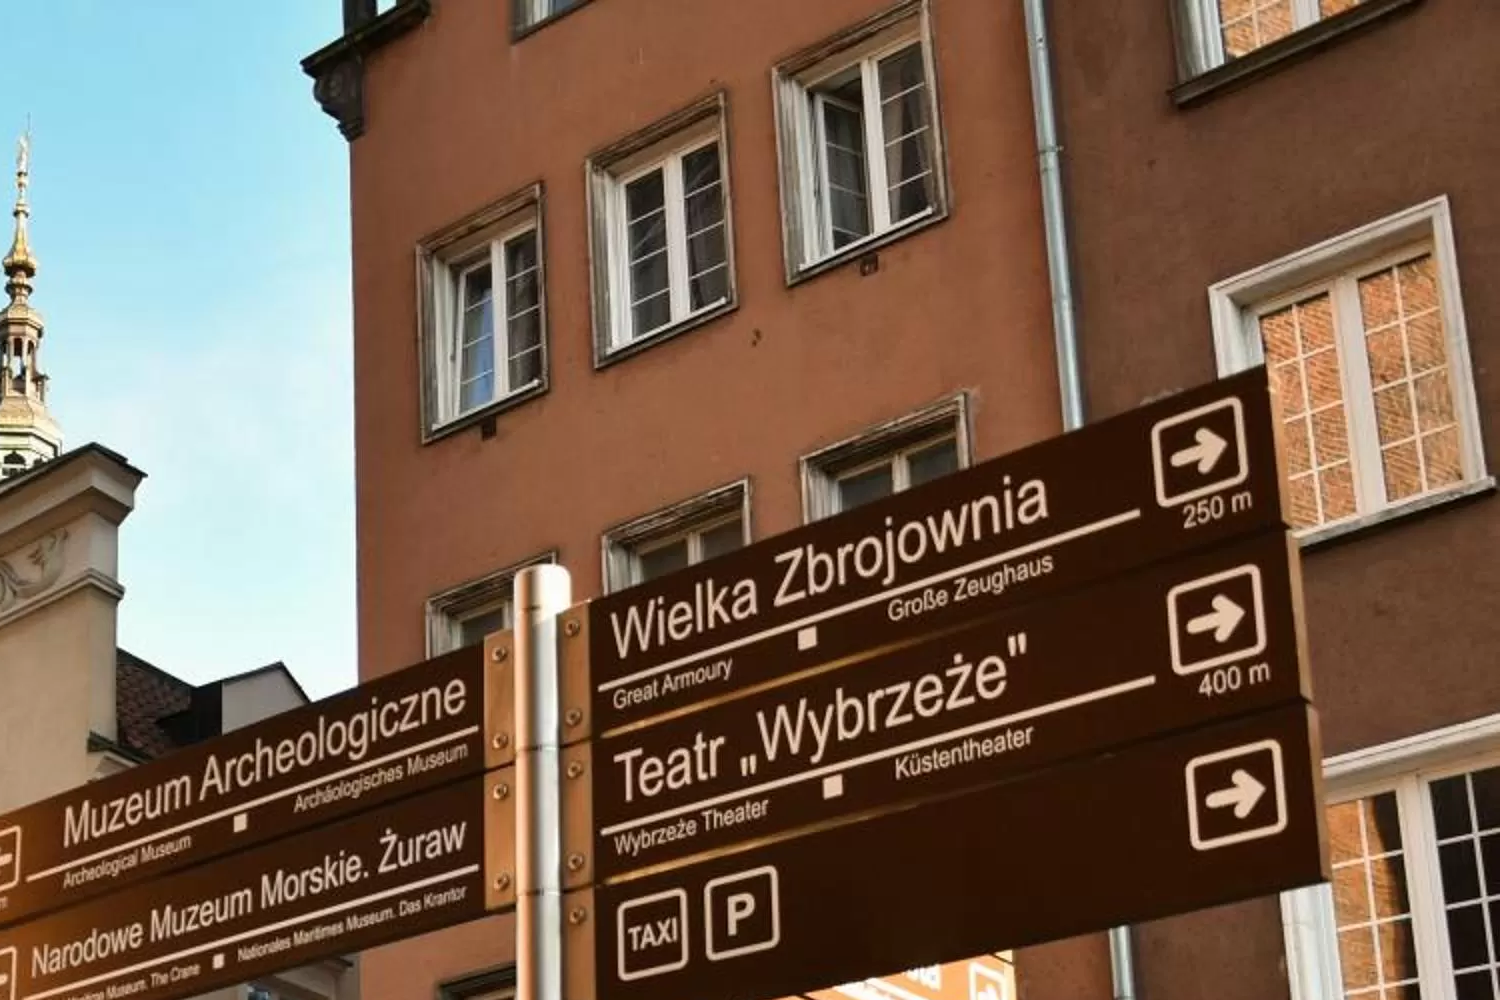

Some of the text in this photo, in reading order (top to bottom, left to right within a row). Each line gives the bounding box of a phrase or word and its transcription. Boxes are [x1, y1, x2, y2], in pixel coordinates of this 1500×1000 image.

[1182, 491, 1252, 529] 250 m
[610, 474, 1049, 659] Wielka Zbrojownia
[887, 553, 1054, 622] Große Zeughaus
[612, 656, 733, 710] Great Armoury
[1198, 662, 1270, 698] 400 m
[63, 678, 467, 849] Muzeum Archeologiczne
[293, 742, 469, 814] Archäologisches Museum
[613, 731, 726, 802] Teatr
[894, 724, 1034, 780] Küstentheater
[614, 799, 769, 857] Wybrzeże Theater
[62, 834, 192, 890] Archeological Museum
[30, 821, 468, 979] Narodowe Muzeum Morskie. Żuraw
[726, 892, 756, 937] P
[627, 916, 678, 952] TAXI
